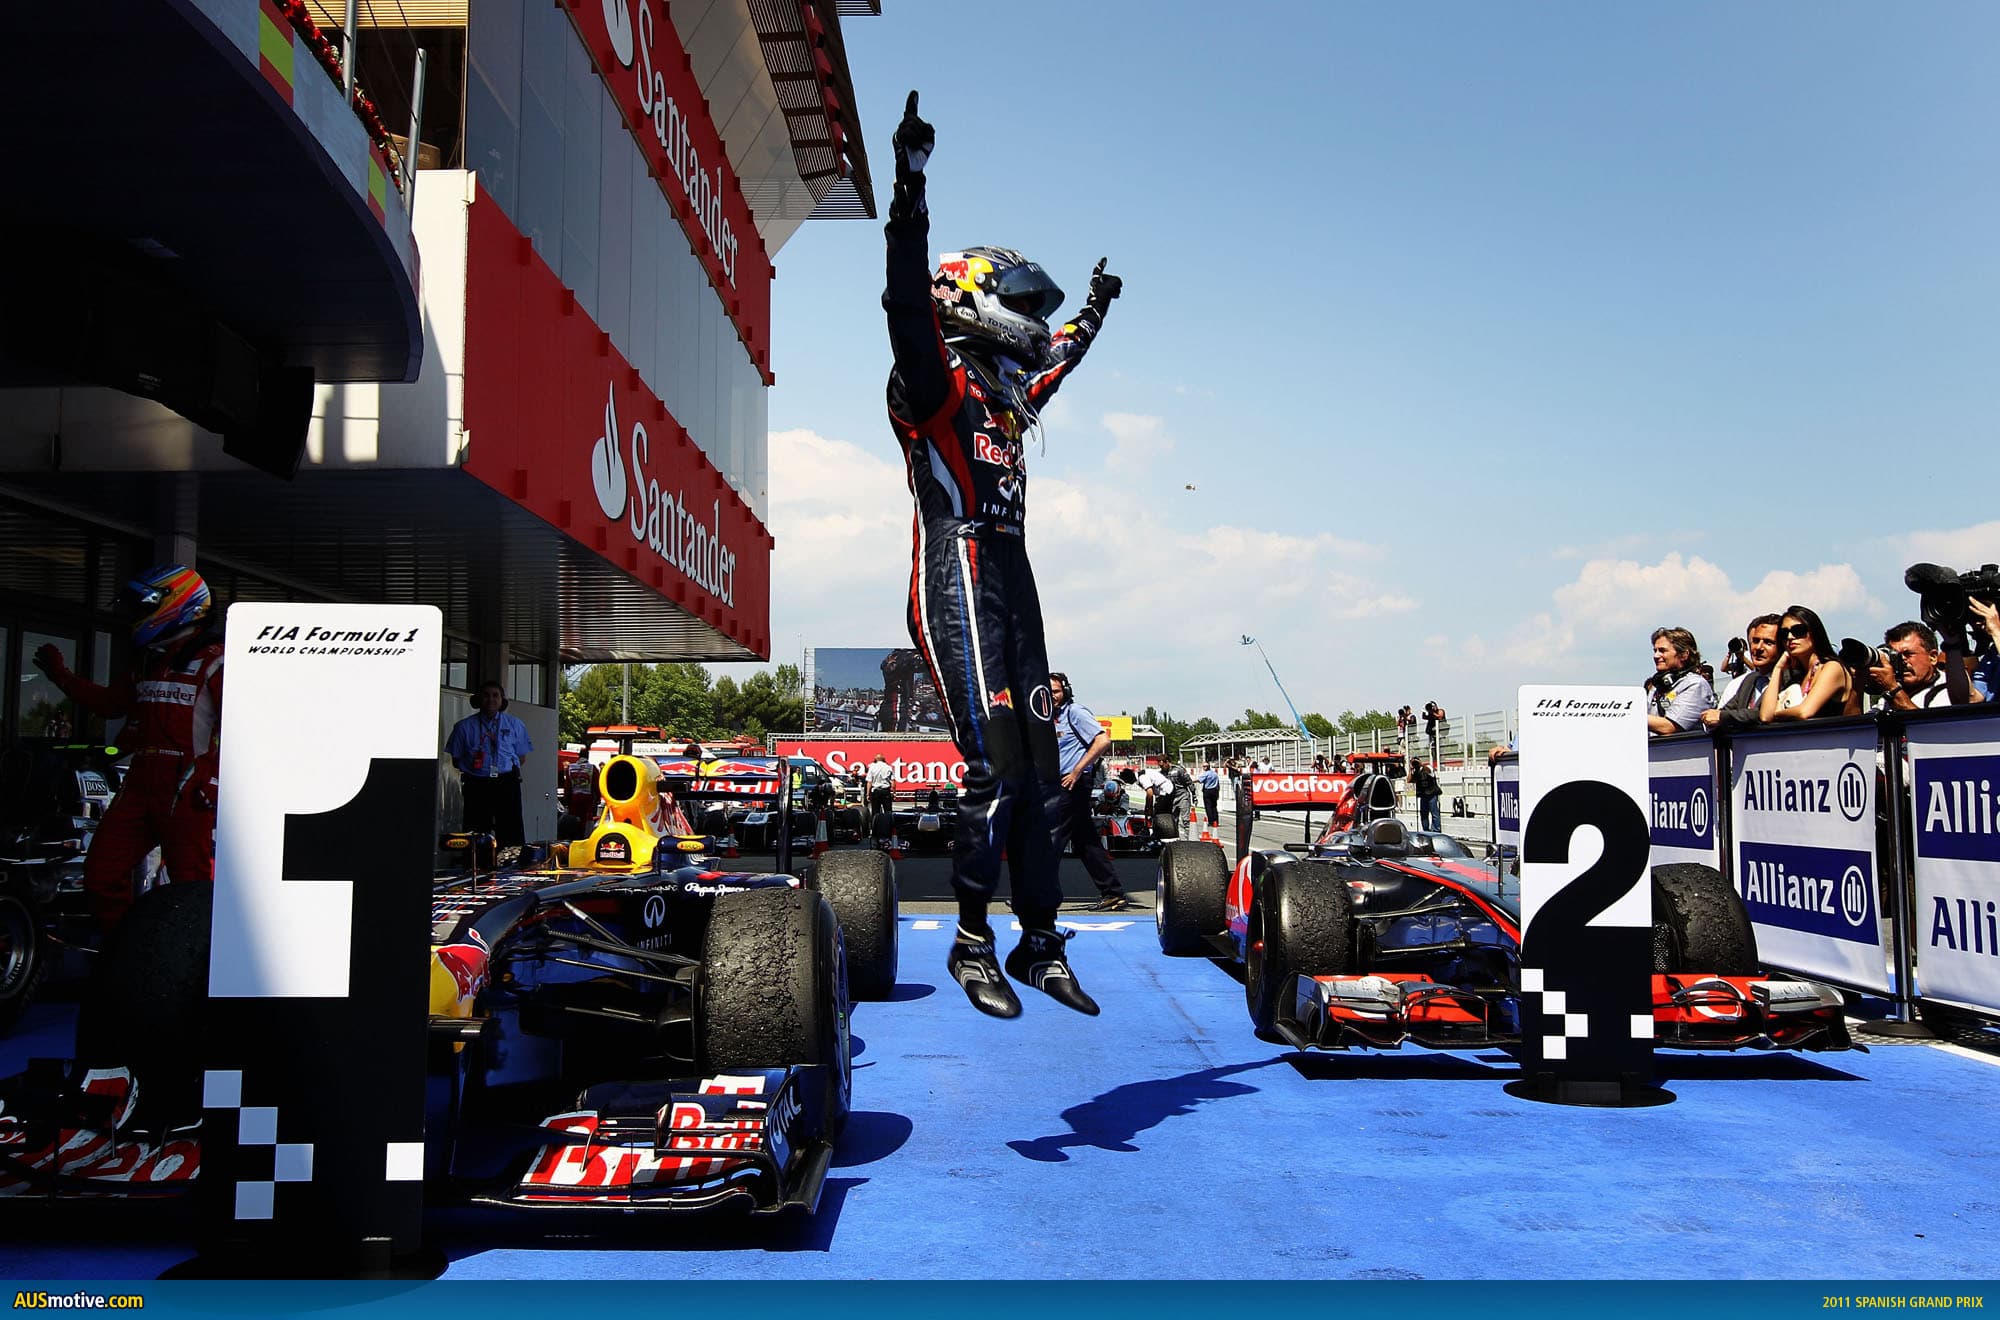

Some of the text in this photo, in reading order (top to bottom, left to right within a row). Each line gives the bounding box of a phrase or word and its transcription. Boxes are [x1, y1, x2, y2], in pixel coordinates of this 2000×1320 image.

[637, 0, 738, 290] Santander
[987, 317, 1014, 333] TOTAL
[631, 421, 736, 608] Santander
[256, 626, 419, 642] FIA Formula 1
[248, 646, 406, 656] WORLD CHAMPIONSHIP
[1536, 699, 1633, 710] FIA Formula 1
[86, 781, 107, 792] BOSS
[1252, 775, 1348, 793] vodafon
[1744, 768, 1831, 813] Allianz
[1500, 793, 1520, 819] Allia
[1925, 779, 2000, 834] Alli
[1522, 779, 1650, 968] 2
[1746, 860, 1835, 915] Allianz
